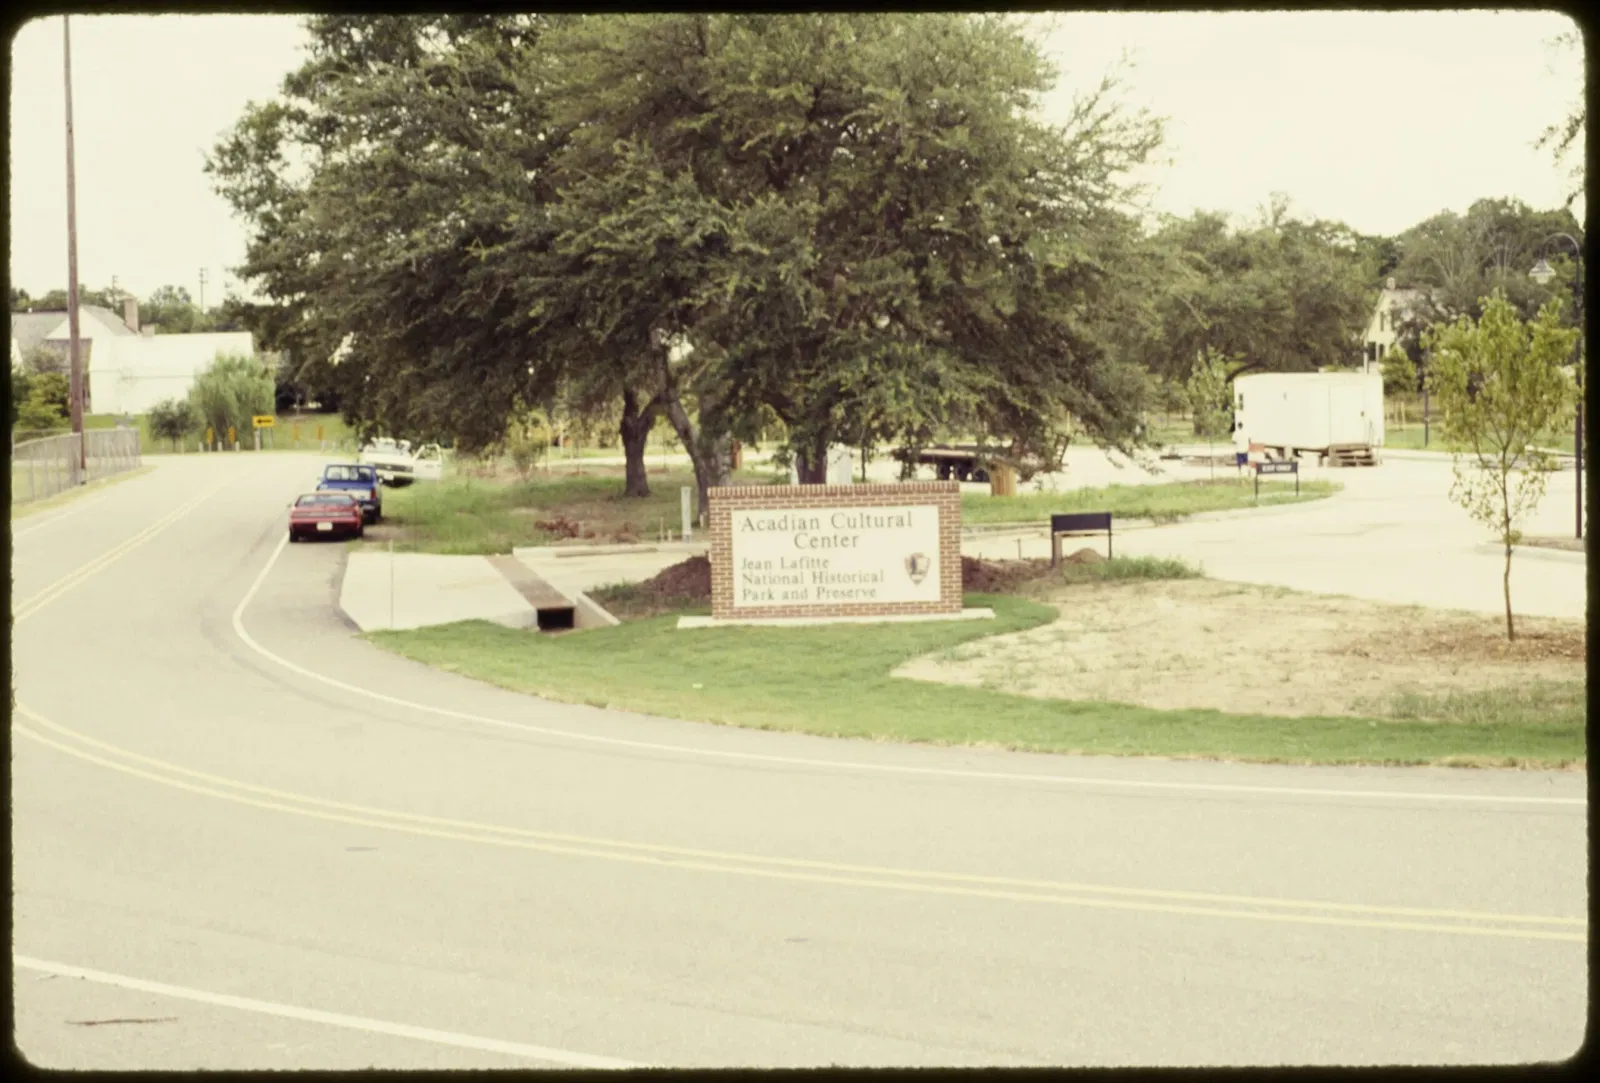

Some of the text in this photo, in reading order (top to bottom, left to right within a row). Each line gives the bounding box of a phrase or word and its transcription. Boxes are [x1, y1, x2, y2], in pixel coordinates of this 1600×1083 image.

[741, 511, 912, 532] Acadian Cultural
[794, 533, 859, 549] Center
[741, 557, 829, 570] Jean Lafitte
[742, 570, 884, 585] National Historical
[742, 587, 876, 601] Park and Preserve
